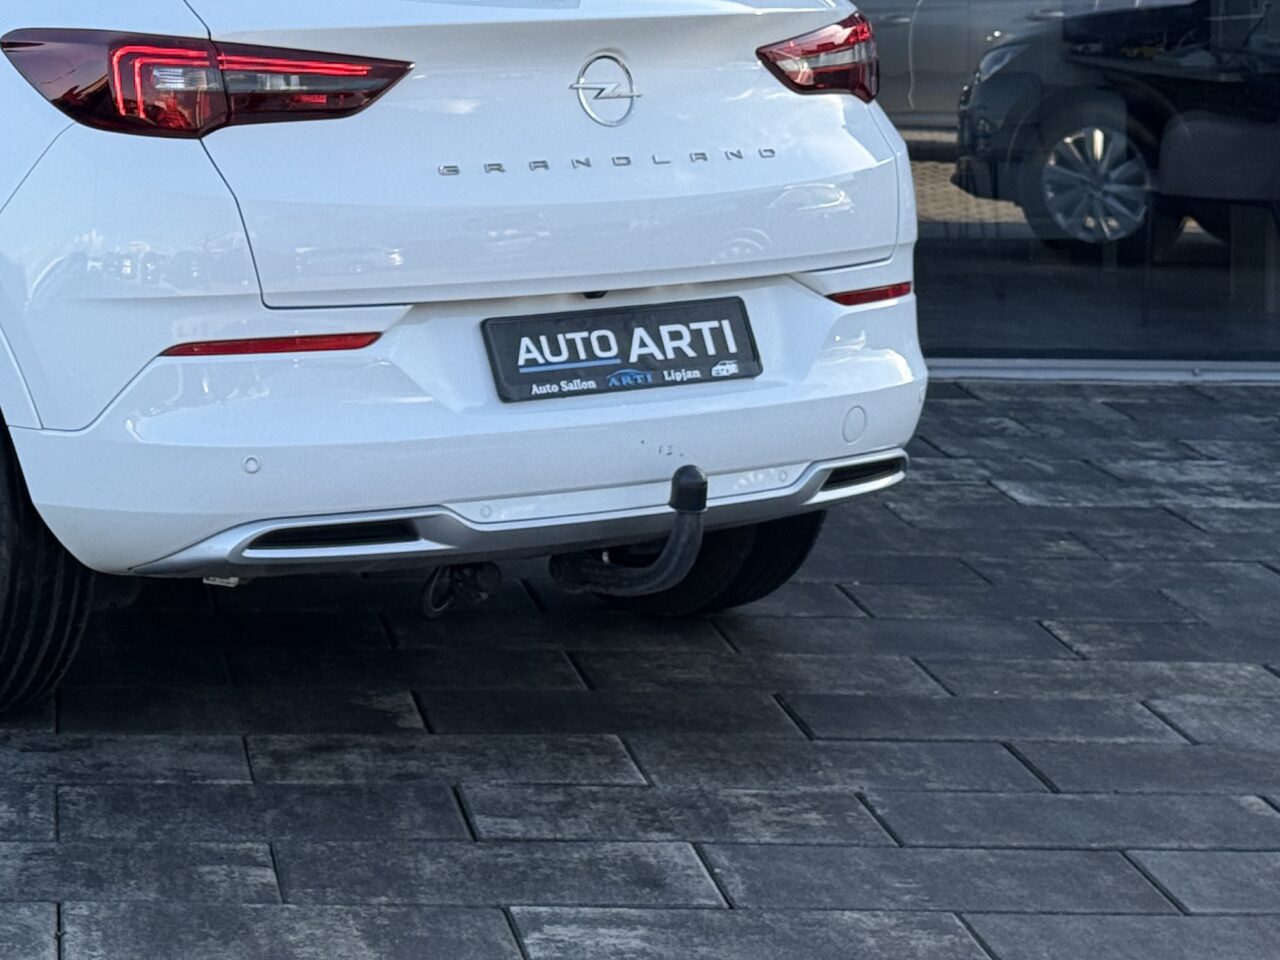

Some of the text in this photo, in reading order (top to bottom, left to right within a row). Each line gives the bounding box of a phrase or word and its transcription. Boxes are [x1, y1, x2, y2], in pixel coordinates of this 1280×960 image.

[438, 147, 776, 176] GRANDLAND
[517, 319, 738, 366] AUTO ARTI
[531, 368, 701, 395] Auto Sallon ARTI Lipjan
